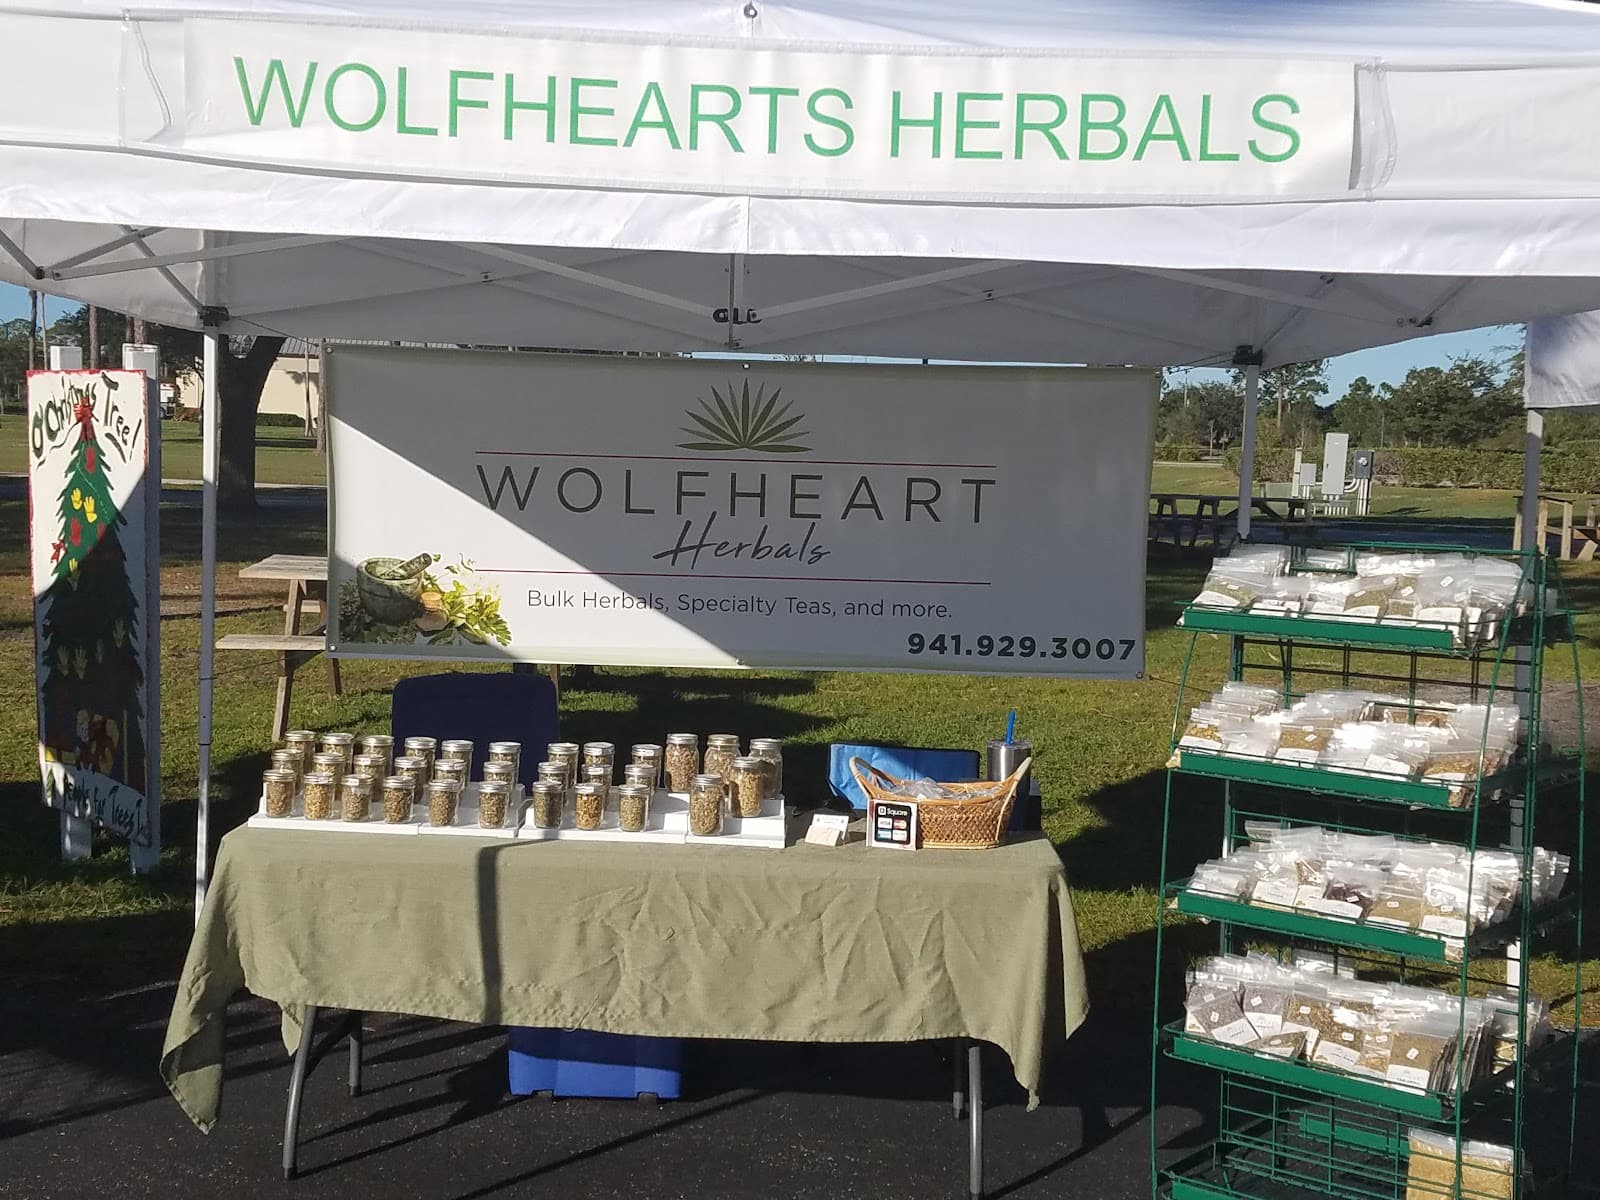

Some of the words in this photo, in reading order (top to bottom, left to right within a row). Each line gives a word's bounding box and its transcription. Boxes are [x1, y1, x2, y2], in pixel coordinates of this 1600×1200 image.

[233, 56, 855, 158] WOLFHEARTS
[889, 90, 1302, 163] HERBALS
[476, 463, 997, 524] WOLFHEART
[652, 511, 831, 570] Herbals
[527, 589, 575, 609] Bulk
[582, 591, 670, 613] Herbals,
[677, 594, 777, 618] Specialty
[784, 596, 837, 617] Teas,
[844, 600, 885, 616] and
[892, 602, 953, 619] more.
[907, 633, 1136, 660] 941.929.3007
[886, 808, 908, 816] Square
